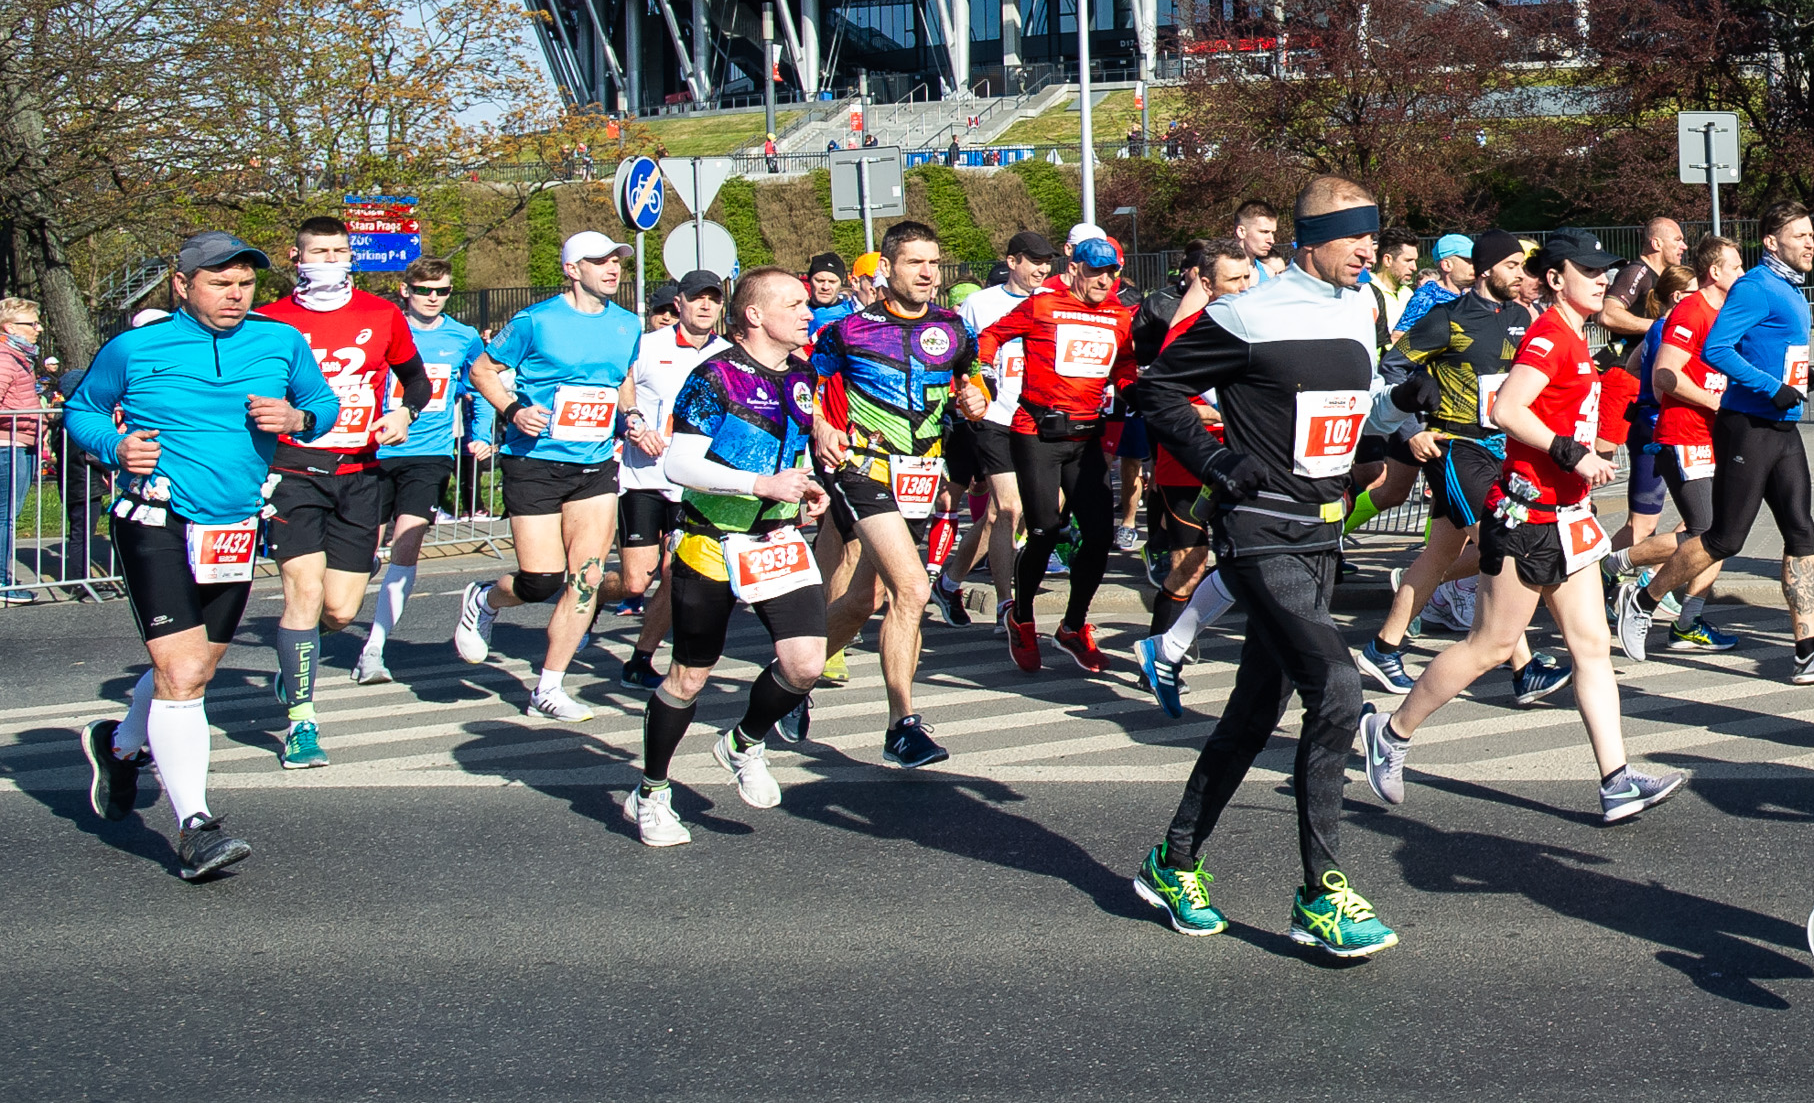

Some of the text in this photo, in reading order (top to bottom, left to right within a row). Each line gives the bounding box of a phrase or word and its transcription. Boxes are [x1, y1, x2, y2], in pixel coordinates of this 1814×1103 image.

[350, 220, 401, 233] Stara Praga
[1052, 310, 1117, 326] FINISHER
[1071, 341, 1109, 359] 3430
[339, 408, 365, 426] 92
[567, 403, 608, 421] 3942
[1323, 418, 1353, 444] 102
[900, 475, 934, 495] 1386
[212, 532, 252, 554] 4432
[749, 544, 799, 574] 2938
[294, 641, 315, 700] kalenji
